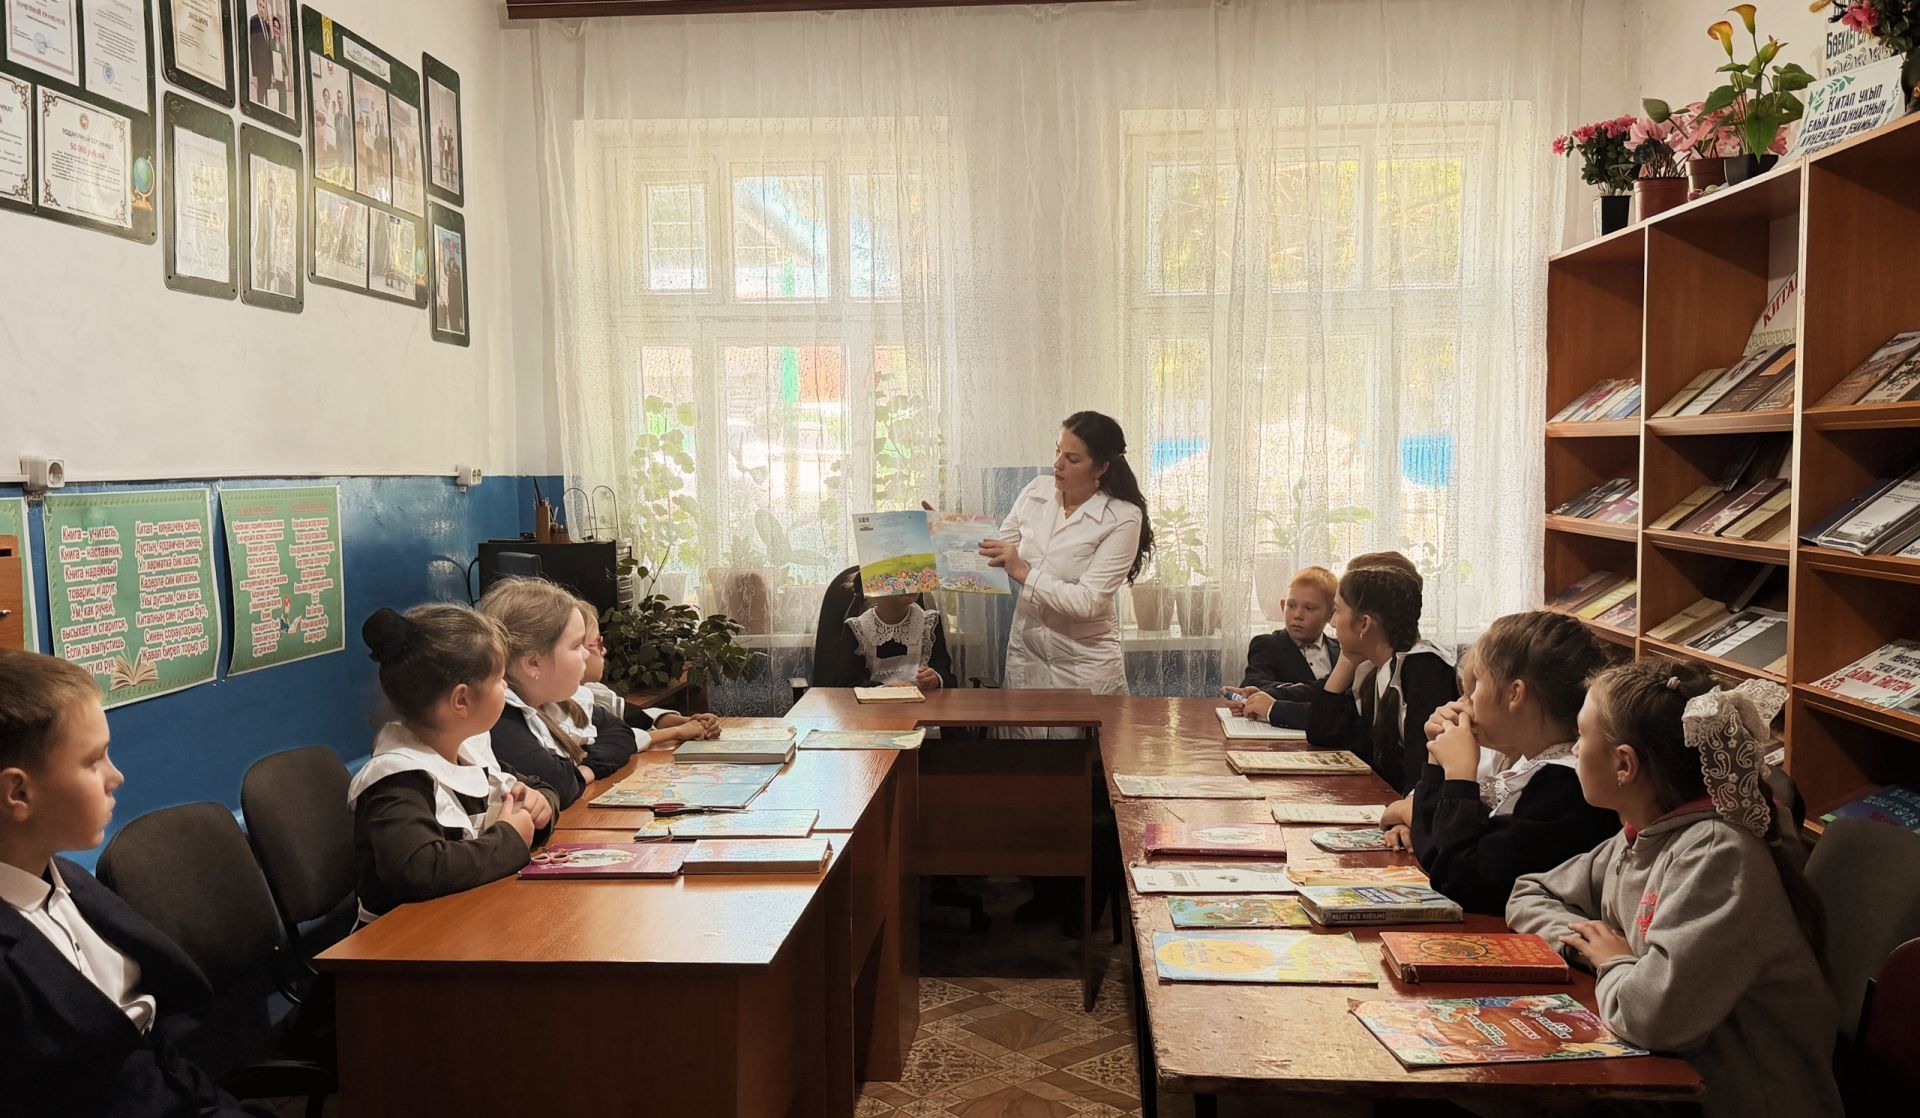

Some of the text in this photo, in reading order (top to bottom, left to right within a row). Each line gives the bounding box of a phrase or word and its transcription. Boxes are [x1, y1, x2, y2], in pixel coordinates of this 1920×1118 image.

[62, 527, 82, 541] Книга
[88, 526, 118, 542] учитель,
[136, 522, 153, 536] Китап
[60, 547, 80, 561] Книга
[86, 545, 121, 559] наставник,
[65, 566, 84, 581] Книга
[68, 586, 96, 601] товарищ
[84, 605, 94, 617] как
[62, 625, 92, 641] высыхает
[98, 620, 127, 636] старится,
[66, 638, 125, 660] Если ты выпустишь
[96, 660, 103, 672] из
